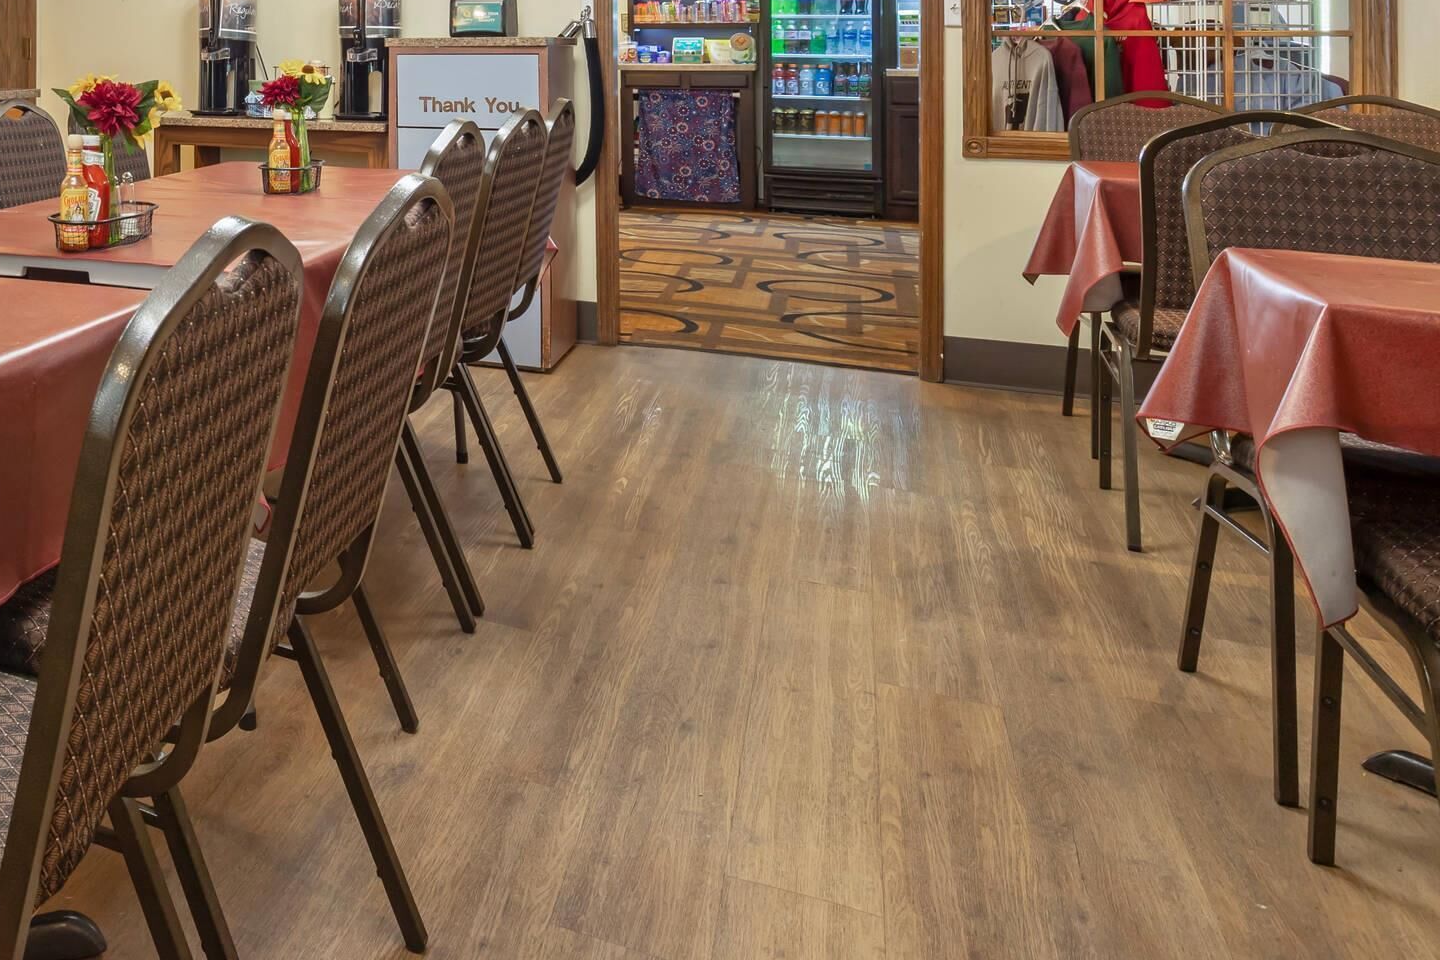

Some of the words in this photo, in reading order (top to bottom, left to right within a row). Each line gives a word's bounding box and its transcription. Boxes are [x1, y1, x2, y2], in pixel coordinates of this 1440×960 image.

[228, 3, 256, 19] Regula
[419, 96, 475, 113] Thank
[485, 96, 520, 113] You
